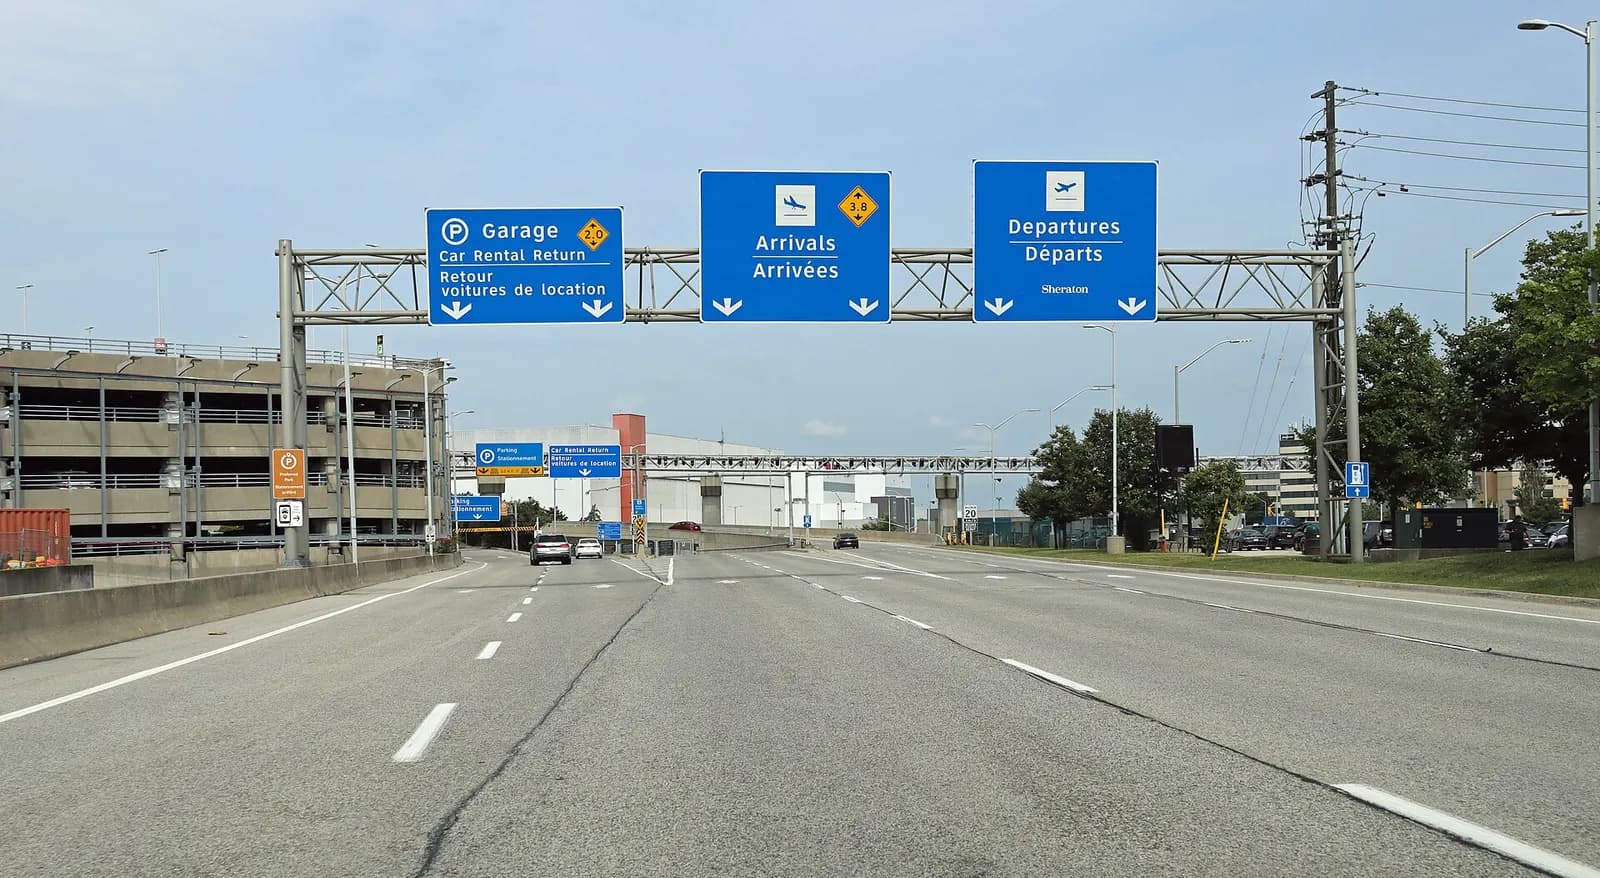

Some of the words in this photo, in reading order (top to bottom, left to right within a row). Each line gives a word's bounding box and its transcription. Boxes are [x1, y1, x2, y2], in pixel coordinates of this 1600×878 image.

[849, 202, 868, 212] 3.8
[482, 223, 559, 243] Garage
[584, 229, 604, 240] 2.0
[1008, 218, 1121, 239] Departures
[755, 234, 837, 252] Arrivals
[439, 250, 466, 262] Car
[473, 249, 525, 262] Rental
[533, 248, 586, 261] Return
[1025, 244, 1103, 266] Départs
[752, 260, 840, 279] Arrivées
[440, 271, 493, 283] Retour
[441, 283, 507, 297] voitures
[514, 283, 533, 296] de
[541, 282, 606, 296] location
[1041, 284, 1089, 295] Sheraton
[965, 509, 977, 518] 20
